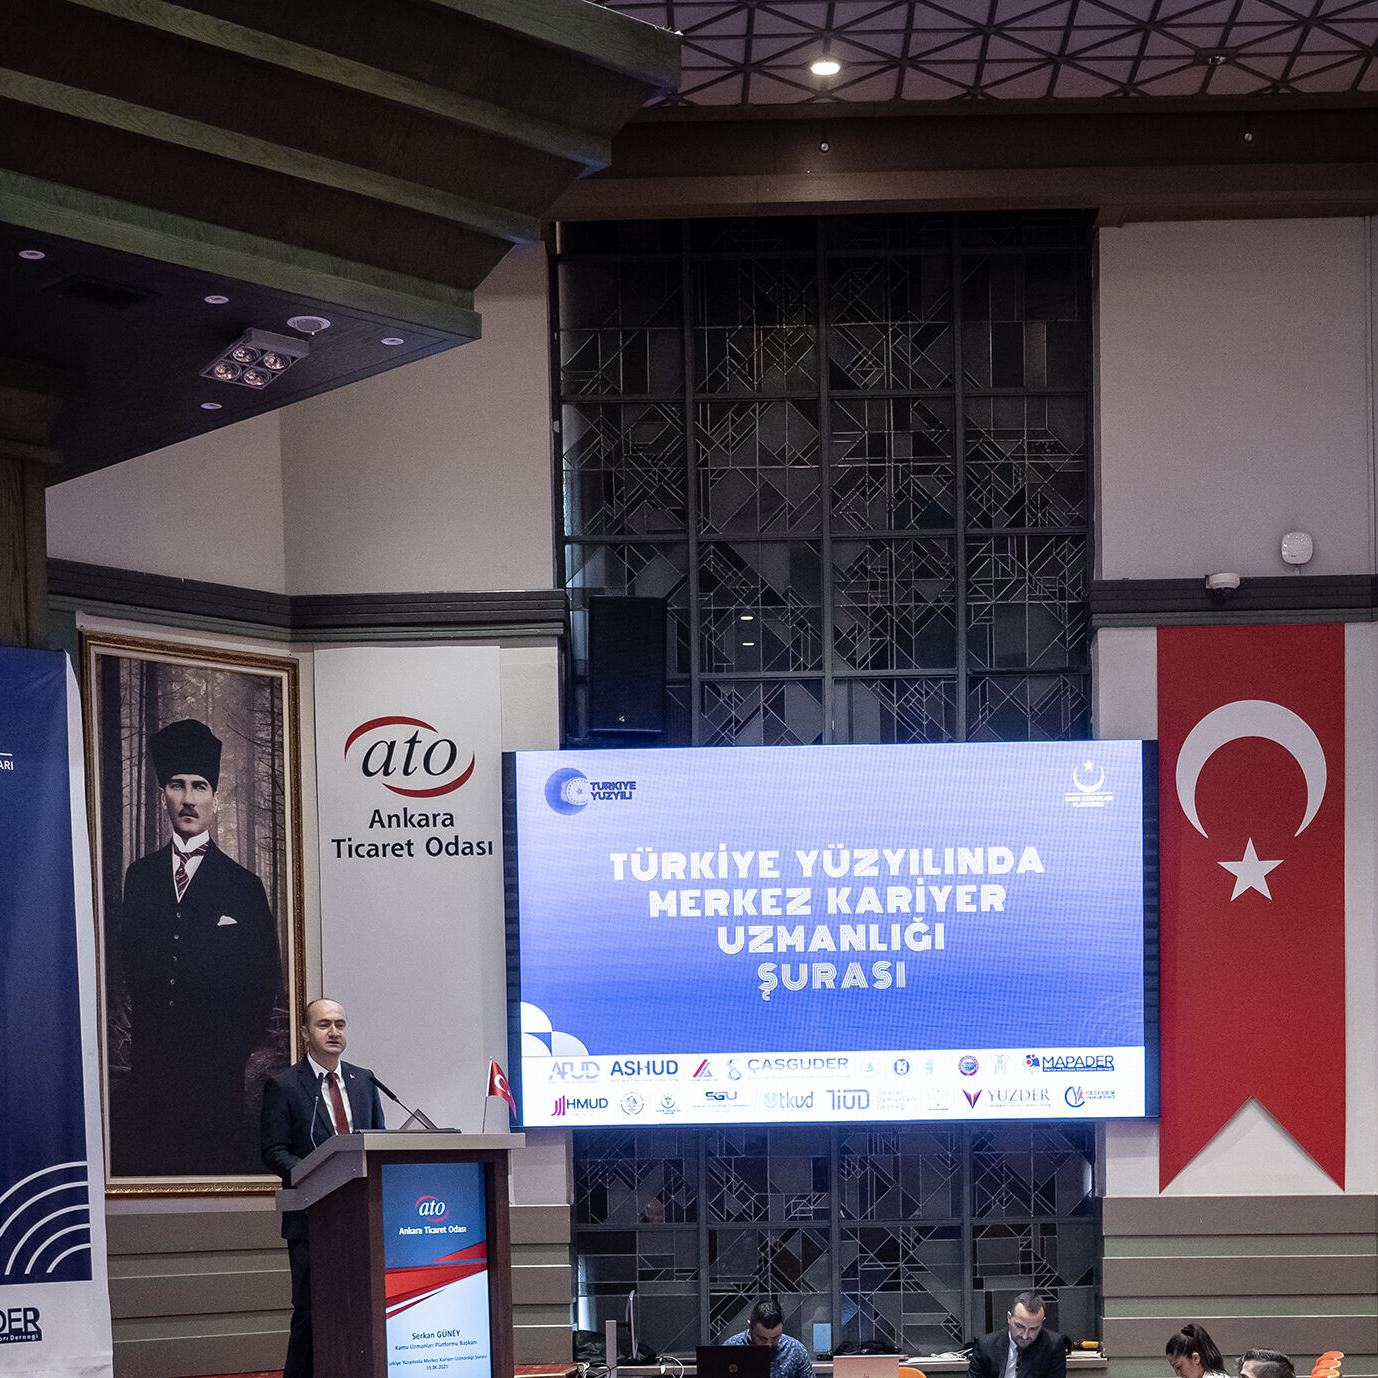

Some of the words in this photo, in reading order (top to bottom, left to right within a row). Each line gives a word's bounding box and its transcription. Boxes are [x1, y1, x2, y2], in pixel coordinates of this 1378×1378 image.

[362, 729, 457, 777] ato
[368, 807, 455, 829] Ankara
[331, 837, 414, 859] Ticaret
[425, 835, 493, 857] Odası
[609, 843, 780, 882] TÜRKİYE
[795, 843, 1045, 878] YÜZYILINDA
[649, 887, 812, 918] MERKEZ
[827, 877, 1007, 915] KARİYER
[717, 917, 945, 955] UZMANLIĞI
[757, 960, 906, 1001] ŞURASI
[610, 1060, 679, 1076] ASHUD
[747, 1057, 849, 1074] ÇASGUDER
[1042, 1055, 1115, 1071] MAPADER
[566, 1098, 609, 1109] HMUD
[705, 1091, 738, 1100] SGU
[779, 1091, 814, 1109] tkud
[987, 1088, 1050, 1101] YUZDER
[418, 1199, 446, 1216] ato
[399, 1227, 423, 1235] Ankara
[424, 1225, 447, 1234] Ticaret
[412, 1332, 435, 1340] Serkan
[437, 1329, 461, 1338] GÜNEY
